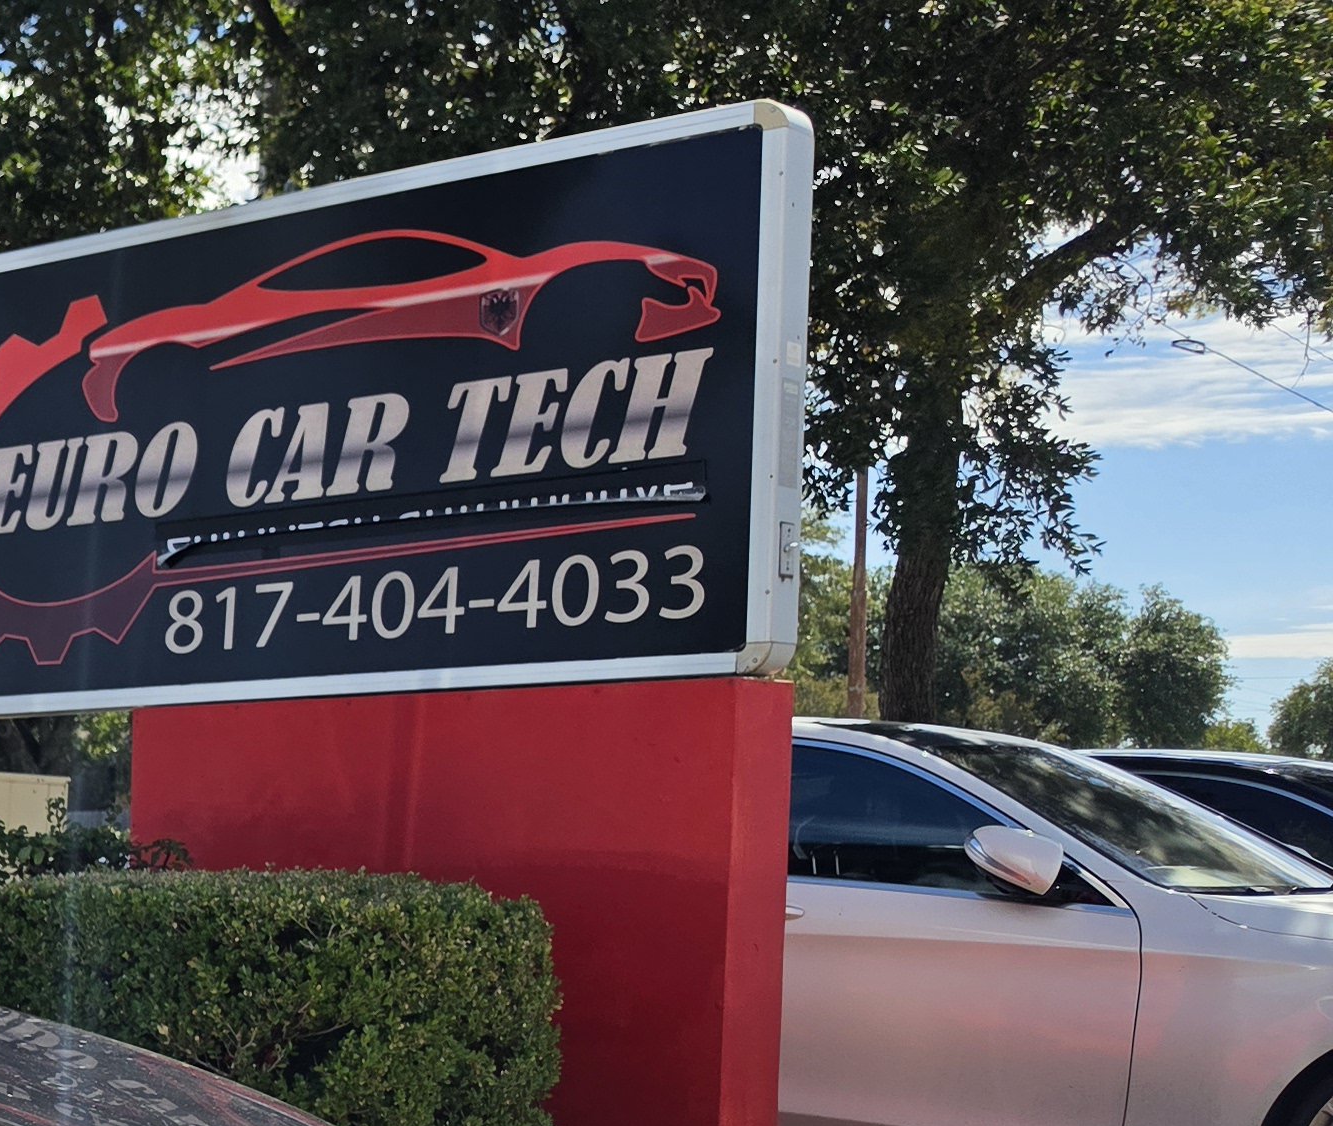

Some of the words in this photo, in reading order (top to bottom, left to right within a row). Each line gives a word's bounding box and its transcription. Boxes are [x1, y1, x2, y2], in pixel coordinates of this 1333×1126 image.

[225, 392, 410, 509] CAR
[440, 346, 715, 486] TECH
[164, 544, 706, 655] 817-404-4033
